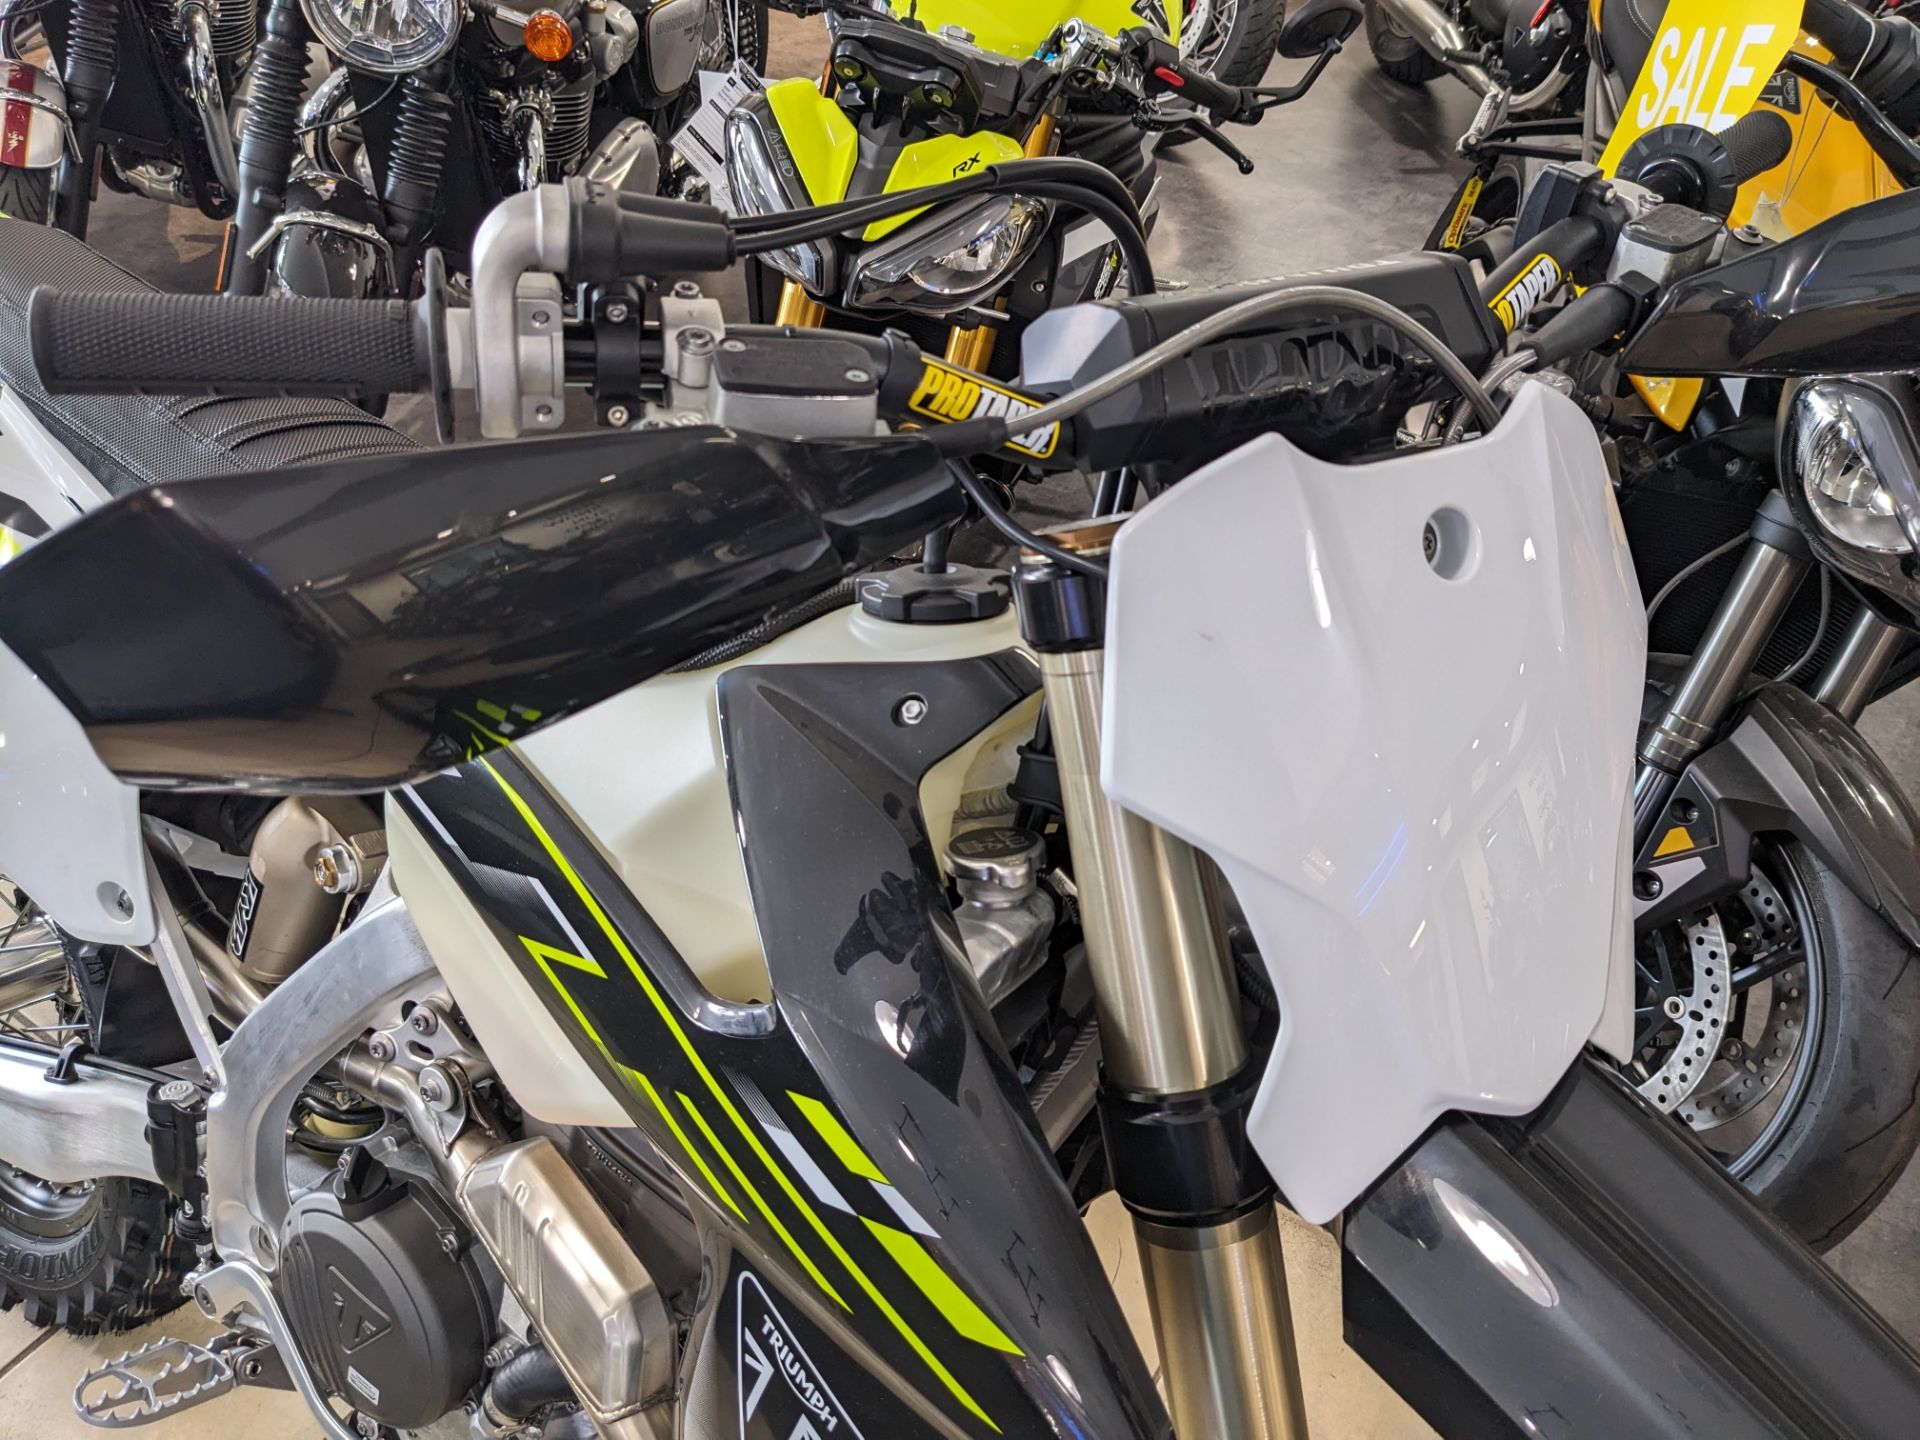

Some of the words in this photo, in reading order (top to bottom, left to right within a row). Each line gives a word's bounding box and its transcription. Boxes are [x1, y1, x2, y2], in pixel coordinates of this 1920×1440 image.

[1637, 24, 1776, 134] SALE
[952, 151, 981, 178] RX
[1494, 258, 1558, 335] OTAPER
[762, 1313, 839, 1432] TRIUMPH
